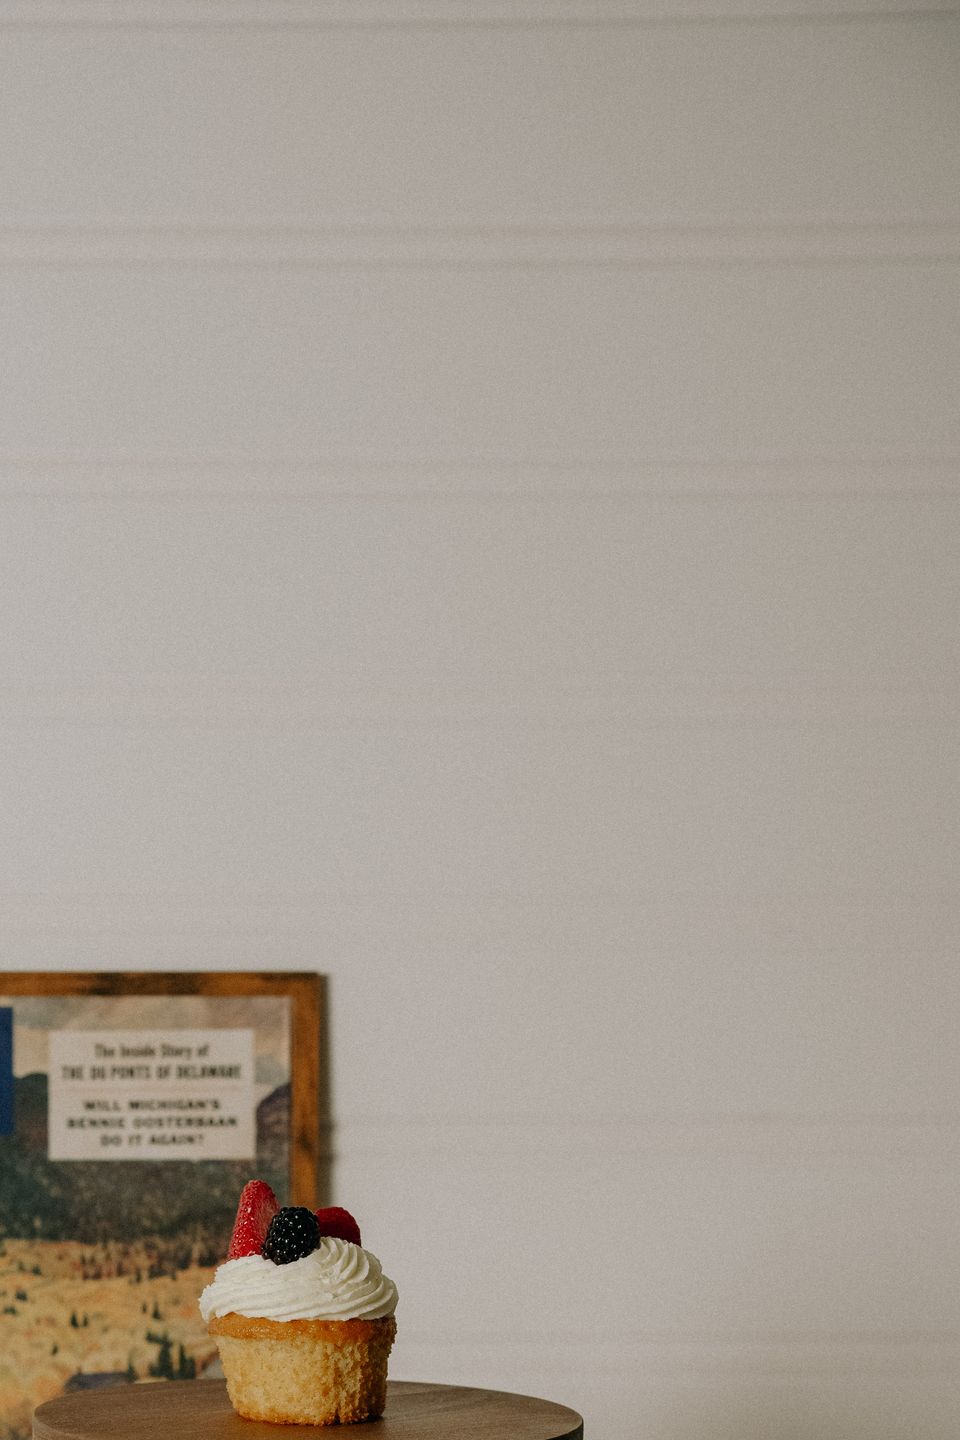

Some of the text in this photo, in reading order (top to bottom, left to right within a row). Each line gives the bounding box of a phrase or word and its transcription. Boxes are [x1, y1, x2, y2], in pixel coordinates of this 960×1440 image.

[95, 1043, 210, 1061] The Inside Story of
[62, 1066, 84, 1080] THE
[156, 1065, 171, 1079] OF
[176, 1065, 241, 1079] DELAWARE
[84, 1101, 120, 1111] WILL
[100, 1135, 123, 1146] DO
[128, 1135, 142, 1145] IT
